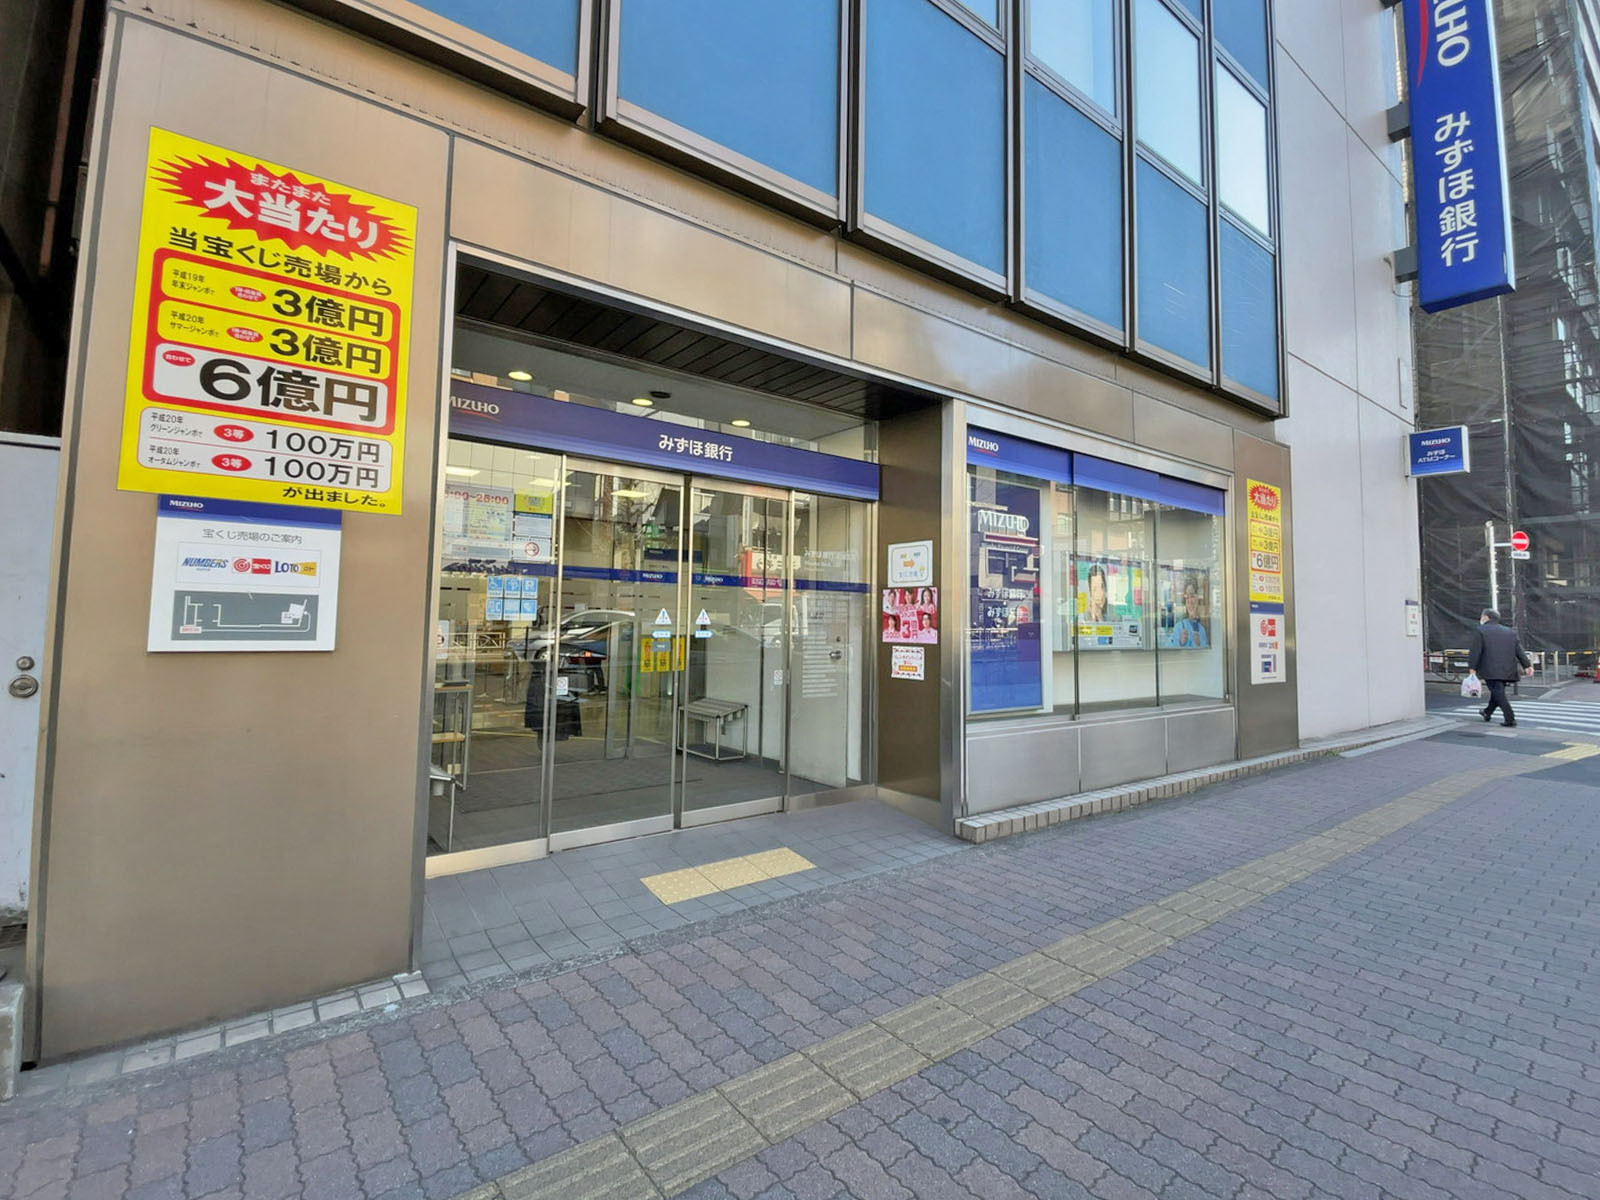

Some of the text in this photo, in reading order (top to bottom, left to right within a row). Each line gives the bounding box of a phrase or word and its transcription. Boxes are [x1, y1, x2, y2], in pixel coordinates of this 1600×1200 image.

[1432, 0, 1470, 67] UHO
[250, 172, 331, 206] またまた
[1434, 111, 1479, 267] みずほ銀行
[202, 179, 379, 250] 大当たり
[168, 226, 393, 297] 当宝くじ売場から
[172, 269, 205, 283] 平成19年
[170, 310, 205, 324] 平成20年
[272, 289, 384, 337] 3億円
[269, 328, 382, 374] 3億円
[199, 358, 379, 422] 6億円
[151, 412, 183, 424] 平成20年
[224, 428, 245, 440] 3等
[1421, 438, 1451, 446] MIZUHO
[148, 444, 180, 456] 平成20年
[265, 429, 380, 463] 100万円
[658, 434, 733, 462] みずほ銀行
[968, 436, 999, 452] MIZUHO
[221, 457, 242, 469] 3等
[1417, 454, 1456, 463] ATMコーナー
[264, 456, 379, 488] 100万円
[169, 500, 204, 509] MIZUHO
[282, 486, 386, 508] が出ました。
[980, 511, 1029, 531] MIZUHO
[202, 528, 302, 544] 宝くじ売場のご案内
[182, 556, 229, 569] NUMBERS
[275, 560, 300, 573] LOTO
